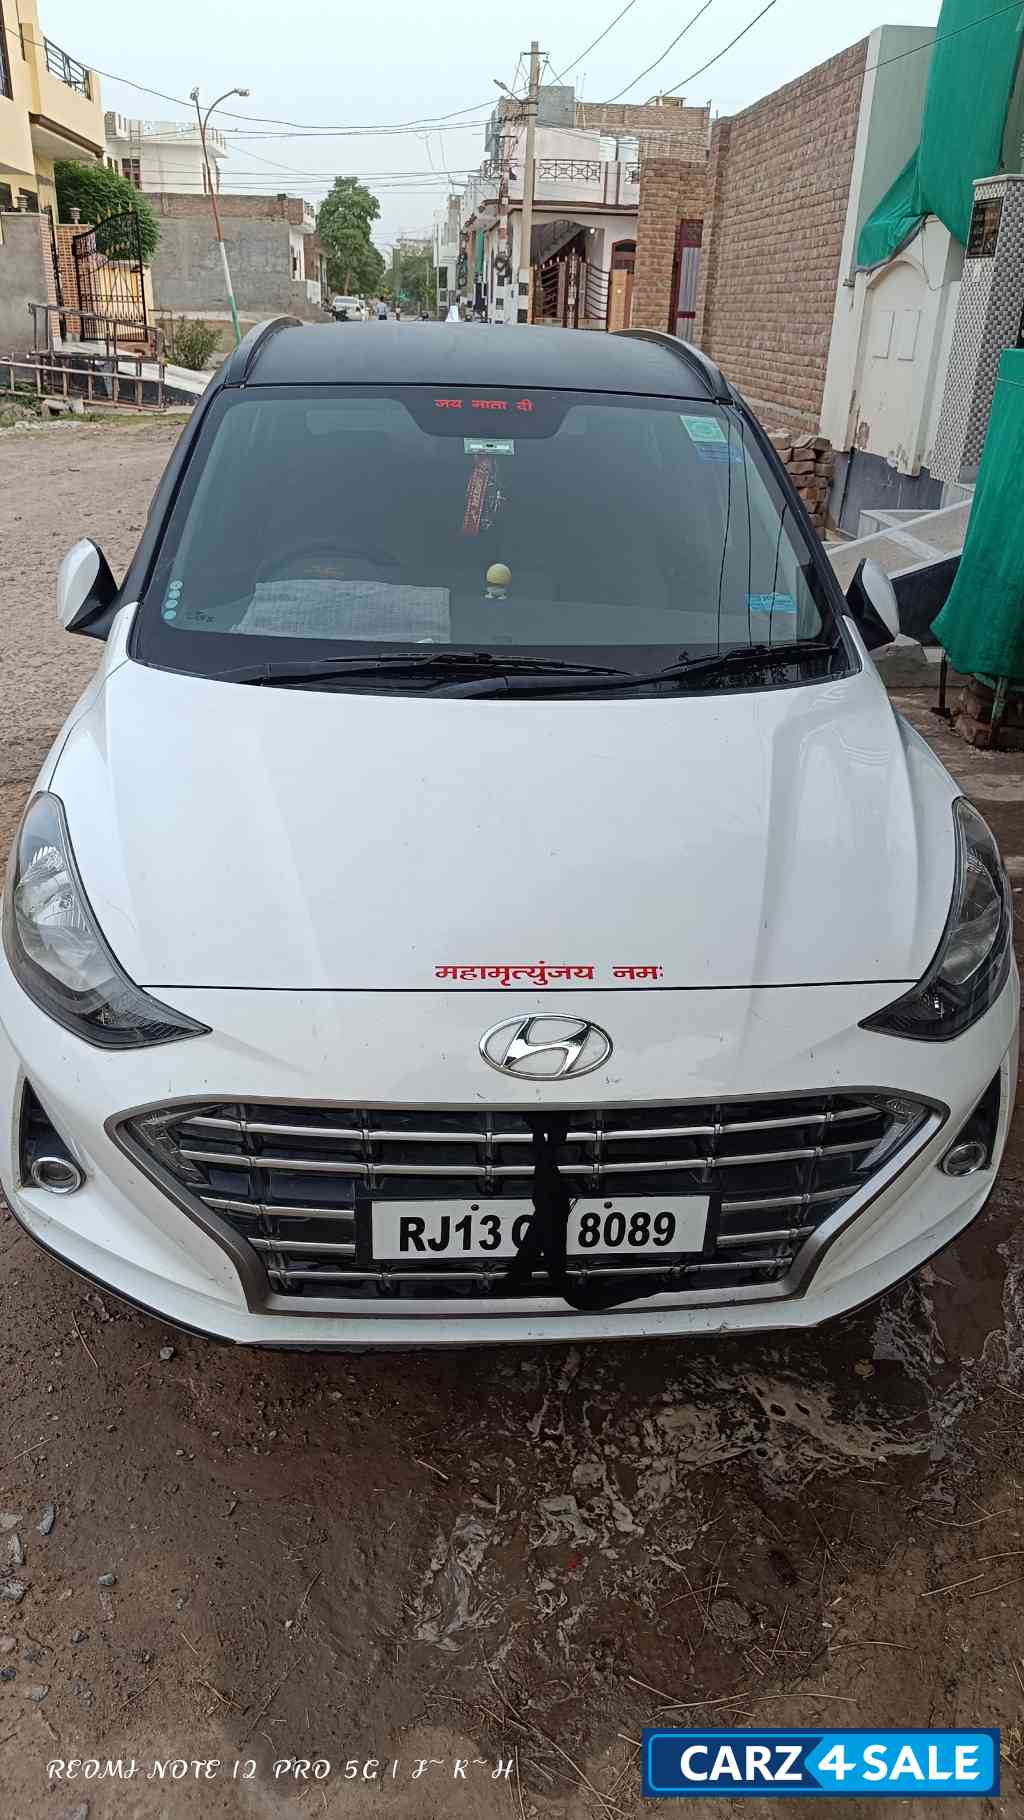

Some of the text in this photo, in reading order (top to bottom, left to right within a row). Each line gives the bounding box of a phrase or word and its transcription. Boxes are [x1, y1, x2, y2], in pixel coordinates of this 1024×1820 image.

[434, 399, 463, 409] जय
[435, 960, 594, 987] महामृत्युंजय
[577, 1211, 677, 1248] 8089
